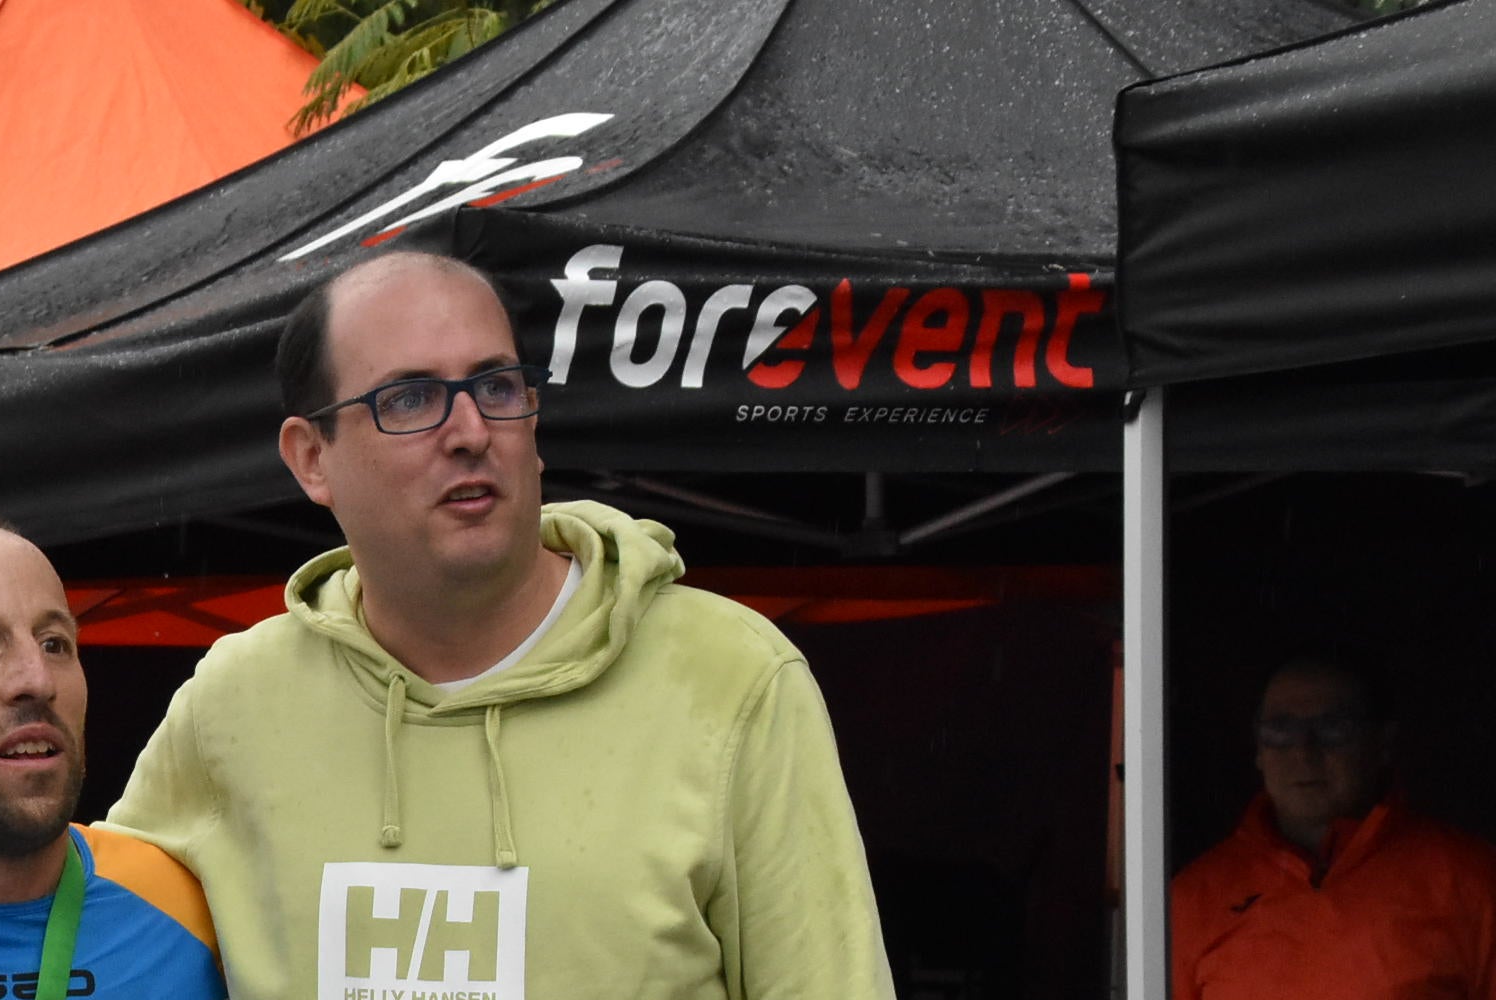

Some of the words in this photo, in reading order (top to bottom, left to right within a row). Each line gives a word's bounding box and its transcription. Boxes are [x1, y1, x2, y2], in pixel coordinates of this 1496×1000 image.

[548, 243, 1106, 390] forevent
[735, 404, 828, 424] SPORTS
[843, 406, 990, 425] EXPERIENCE
